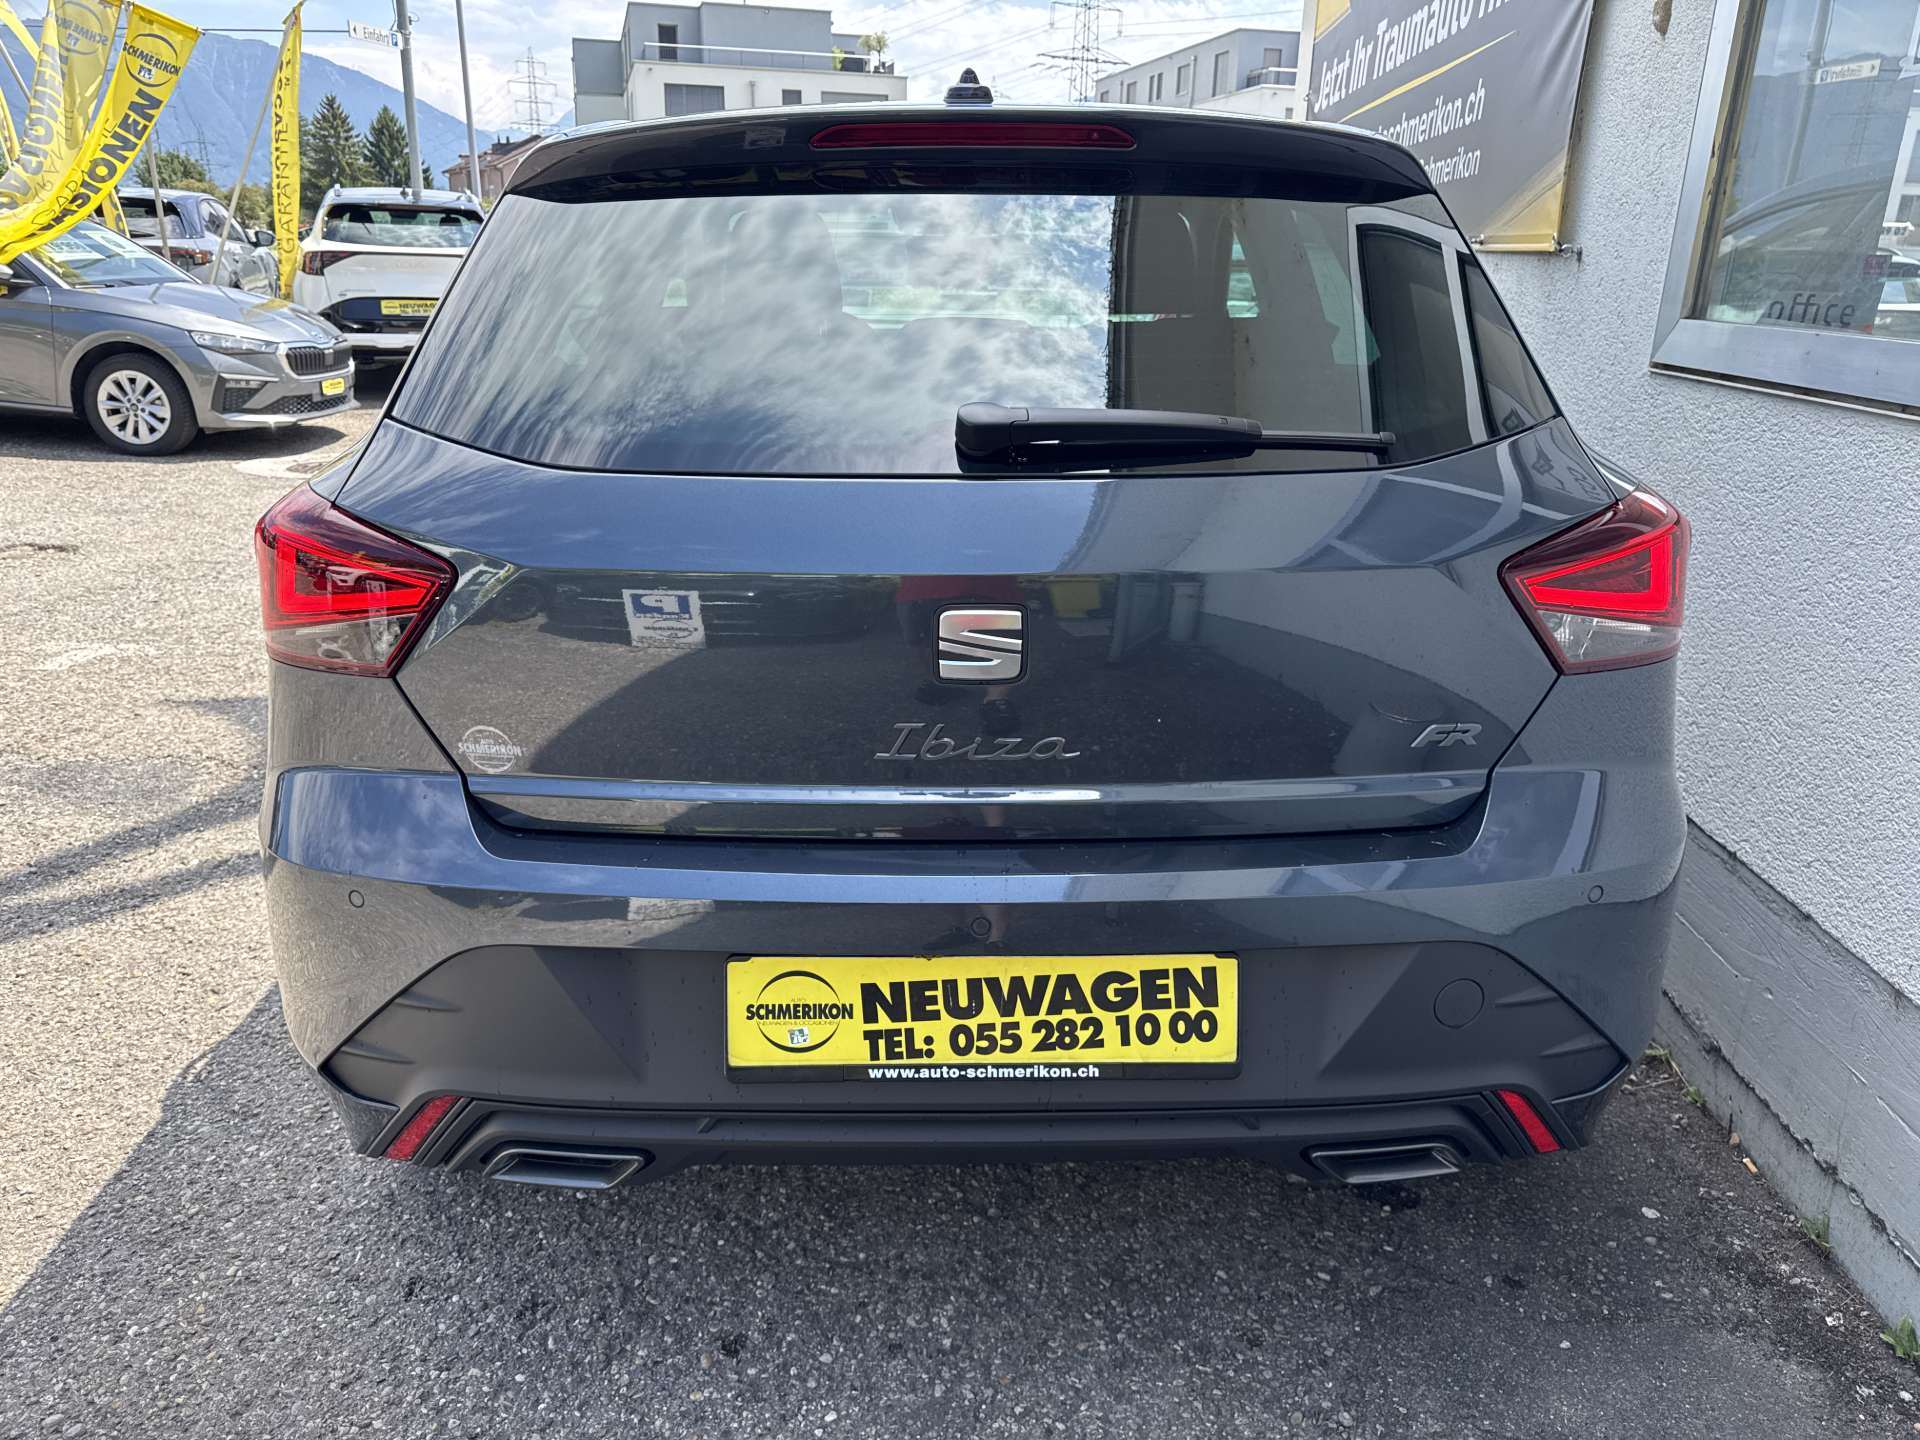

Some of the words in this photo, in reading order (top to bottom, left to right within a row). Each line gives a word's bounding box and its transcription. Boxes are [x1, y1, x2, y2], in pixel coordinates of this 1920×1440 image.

[122, 41, 181, 76] SCHMERIKON
[1314, 50, 1351, 114] Jetzt
[1349, 35, 1374, 94] Ihr
[1420, 146, 1481, 185] chmerikon
[1768, 293, 1856, 326] office
[873, 722, 1081, 760] Ibiza
[1410, 722, 1482, 747] FR
[746, 1003, 854, 1020] SCHMERIKON
[860, 966, 1219, 1024] NEUWAGEN
[863, 1028, 935, 1061] TEL:
[950, 1021, 1023, 1056] 055
[1031, 1017, 1104, 1052] 282
[1115, 1013, 1161, 1046] 10
[1169, 1010, 1218, 1044] 00
[868, 1065, 1100, 1078] www.auto-schmerikon.ch
